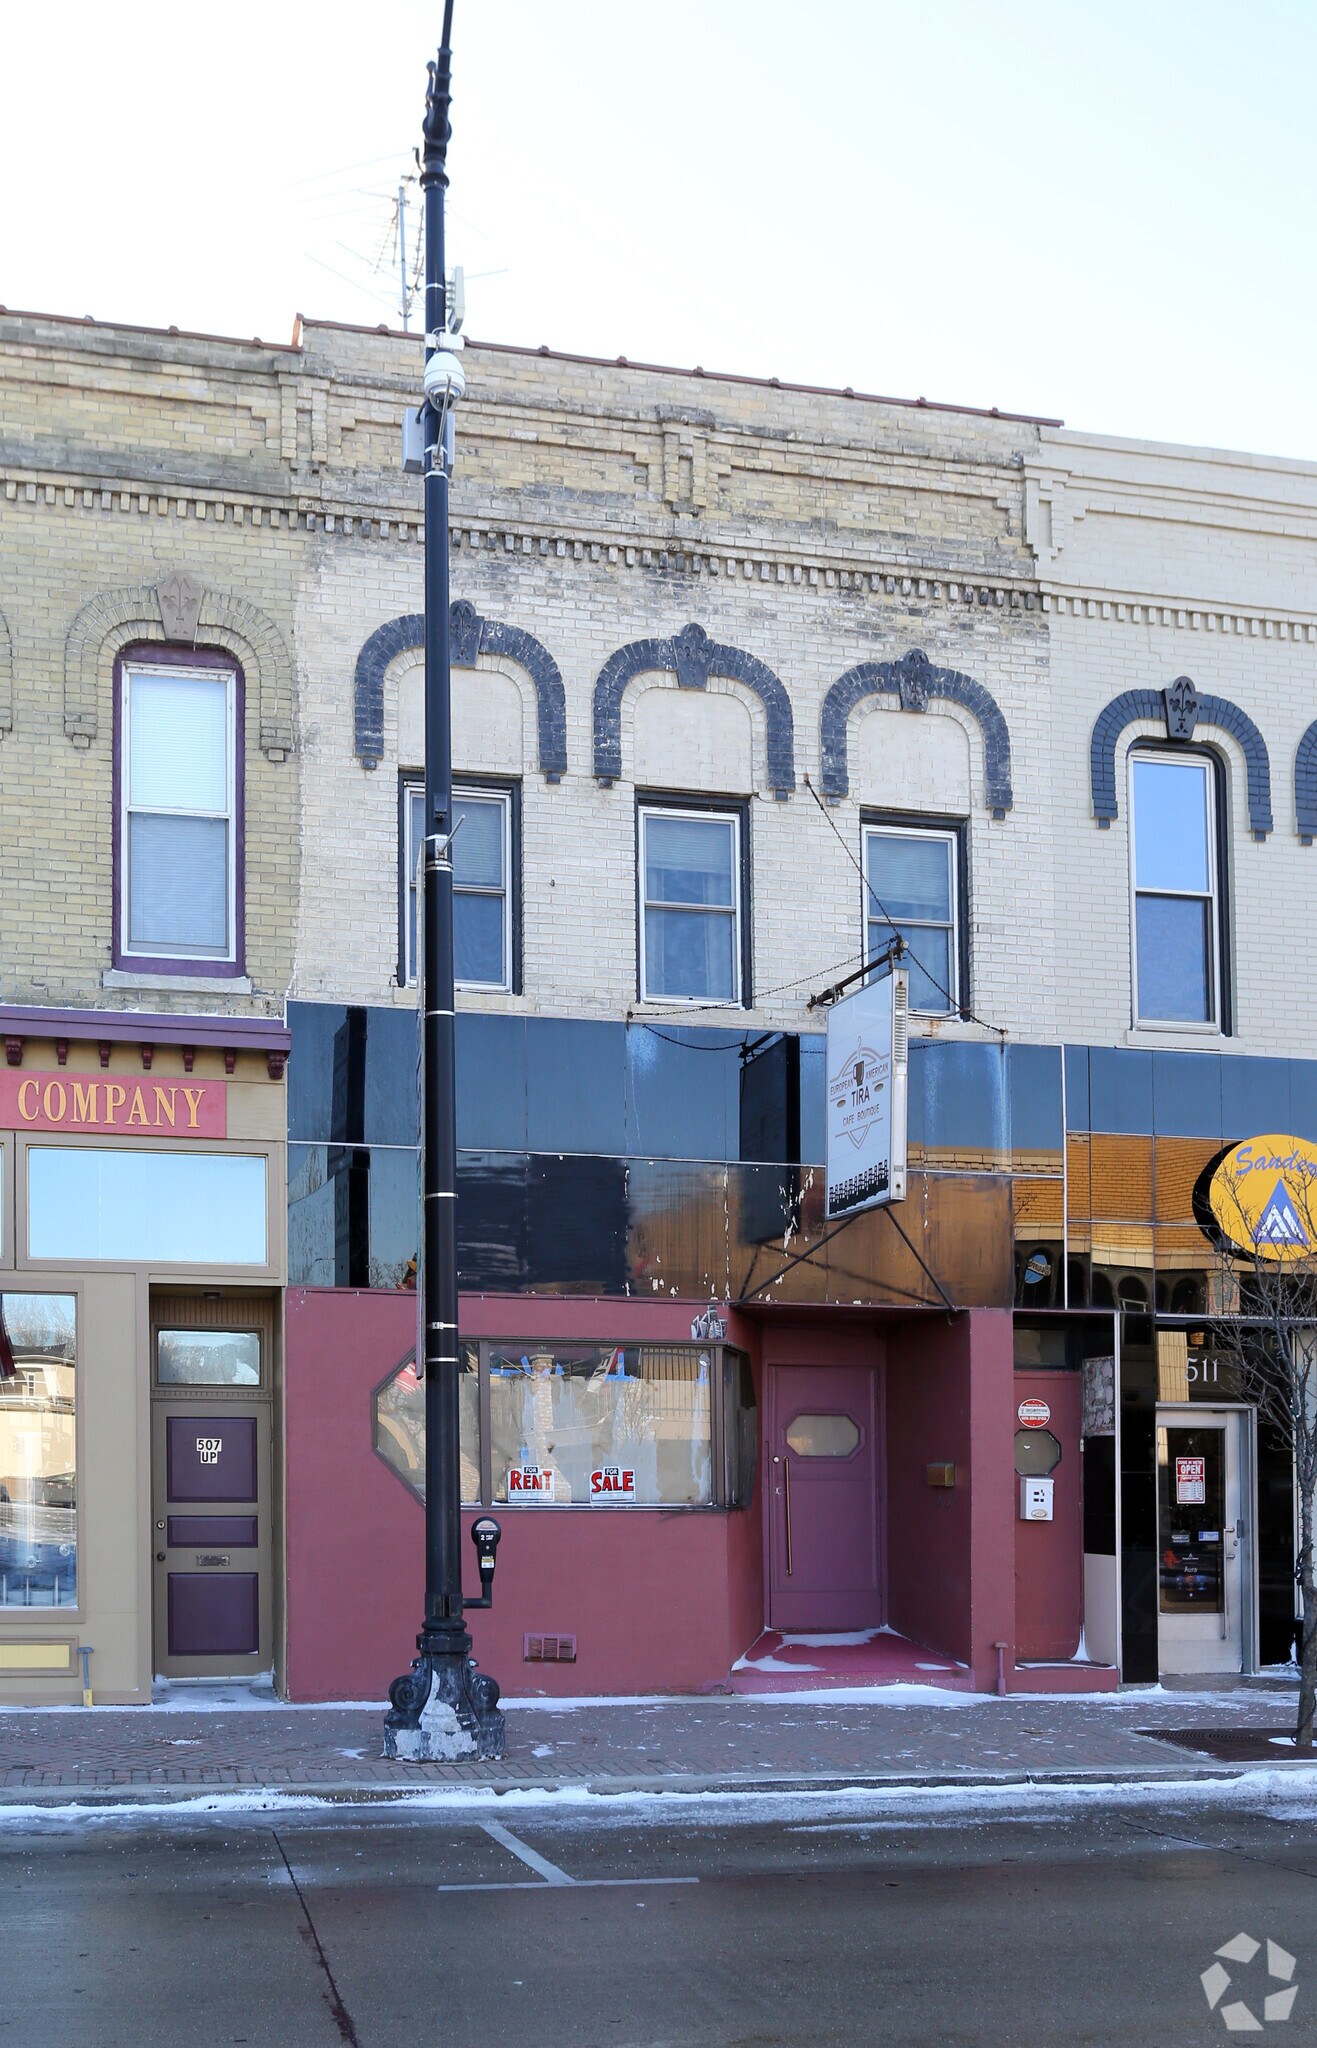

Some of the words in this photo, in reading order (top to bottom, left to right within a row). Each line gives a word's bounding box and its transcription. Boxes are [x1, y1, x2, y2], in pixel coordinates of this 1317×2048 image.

[830, 1077, 854, 1096] EUROPEAN
[865, 1061, 889, 1080] AMERICAN
[18, 1079, 206, 1128] COMPANY
[851, 1085, 870, 1107] TIRA
[842, 1114, 855, 1127] CAFE
[857, 1103, 880, 1120] BOUTIQUE
[1184, 1357, 1218, 1382] 511
[197, 1439, 220, 1451] 507
[201, 1451, 217, 1463] UP
[510, 1470, 552, 1491] RENT
[1180, 1464, 1201, 1475] OPEN
[591, 1471, 635, 1493] SALE
